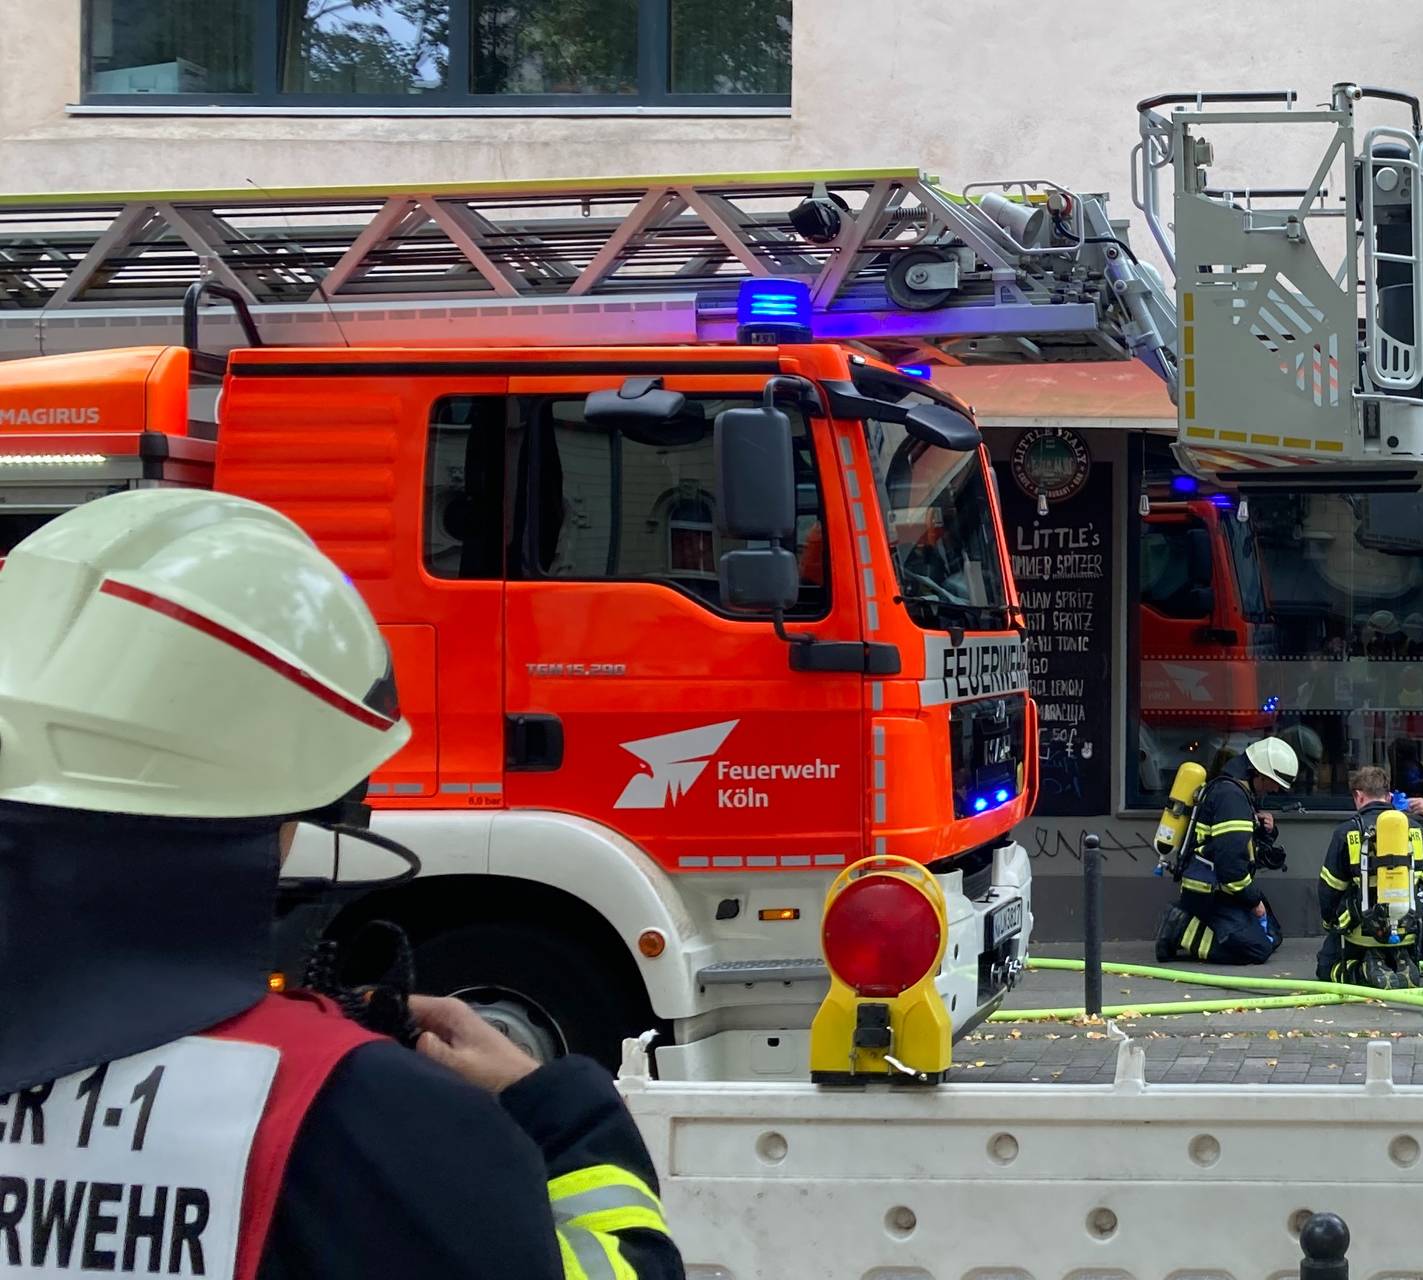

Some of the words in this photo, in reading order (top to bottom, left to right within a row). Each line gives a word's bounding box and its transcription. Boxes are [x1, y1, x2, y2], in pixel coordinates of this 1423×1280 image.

[0, 407, 100, 425] MAGIRUS
[717, 758, 840, 780] Feuerwehr
[718, 787, 769, 808] Köln
[0, 1084, 53, 1144] R
[76, 1062, 165, 1151] 1-1
